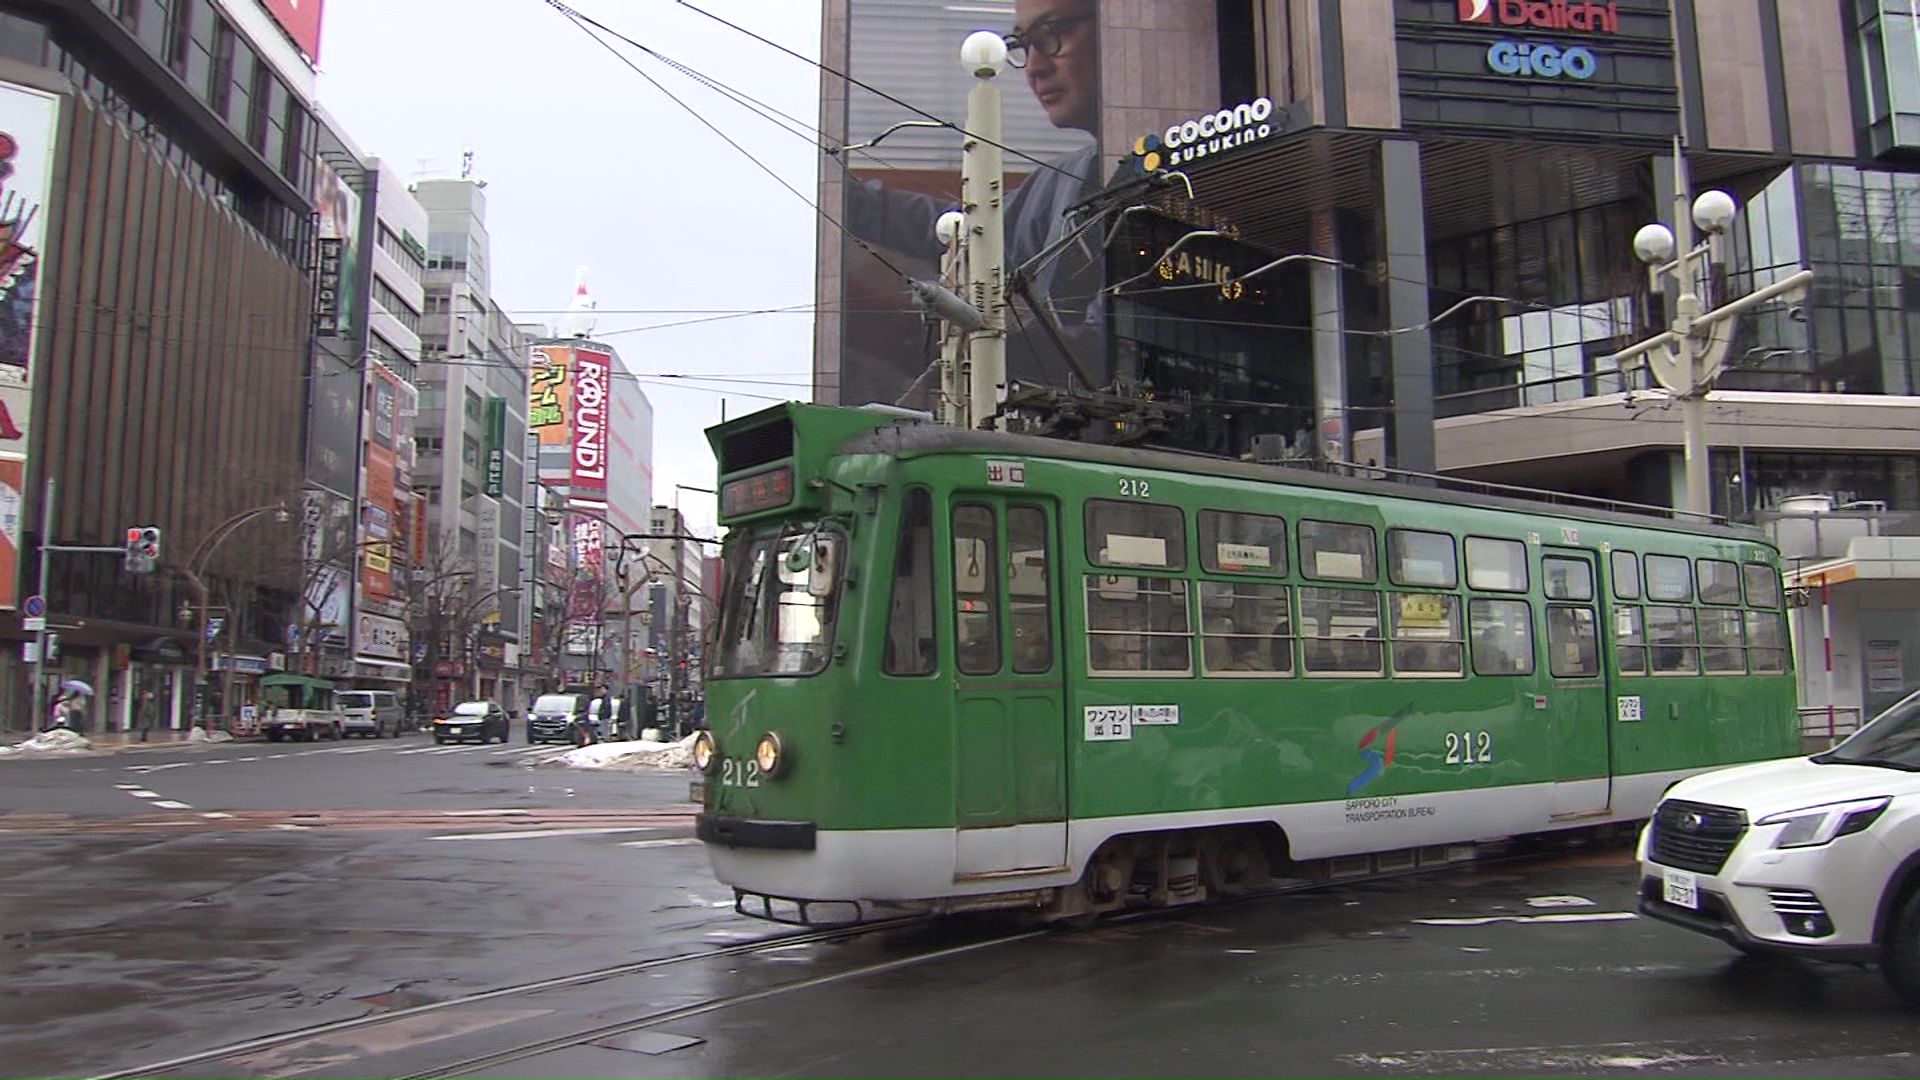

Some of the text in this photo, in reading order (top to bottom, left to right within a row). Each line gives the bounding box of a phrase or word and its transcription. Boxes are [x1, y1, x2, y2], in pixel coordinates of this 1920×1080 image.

[1500, 0, 1618, 32] Daiichi
[988, 465, 1025, 483] 出口
[1119, 478, 1149, 497] 212
[1087, 710, 1128, 722] ワンマン
[1445, 731, 1491, 764] 212
[723, 758, 759, 787] 212
[1345, 797, 1397, 811] SAPPORO CITY
[1345, 807, 1436, 823] TRANSPORTATION BUREAU
